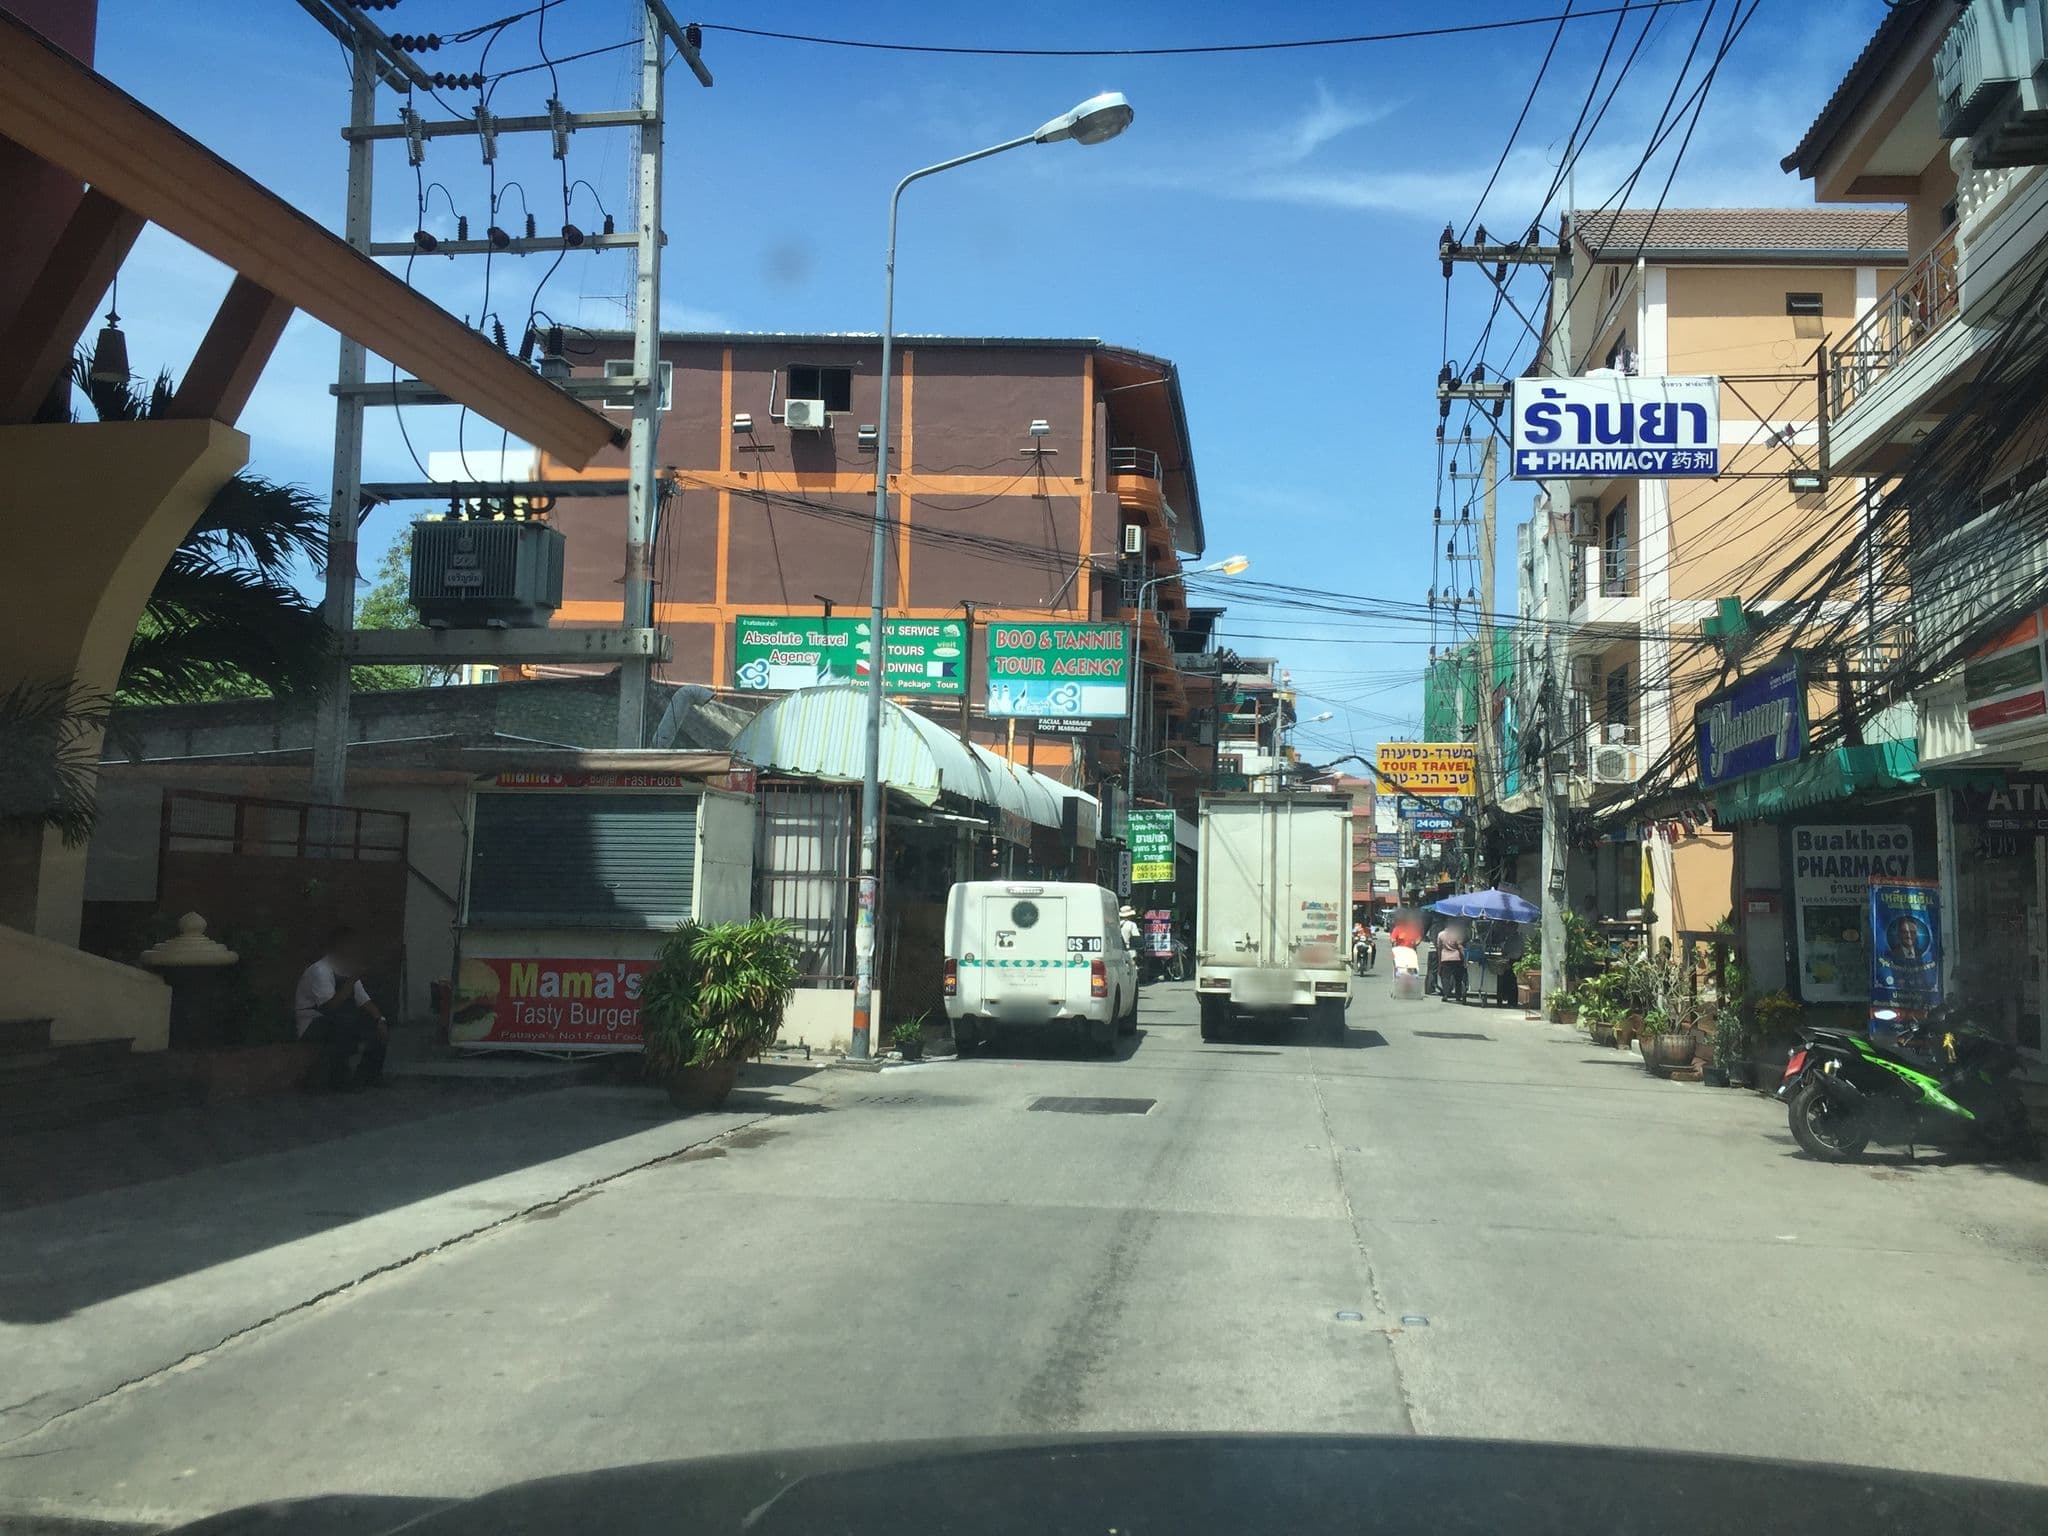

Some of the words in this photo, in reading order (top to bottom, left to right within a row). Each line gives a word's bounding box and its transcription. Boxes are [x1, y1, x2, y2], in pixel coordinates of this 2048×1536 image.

[1524, 388, 1708, 445] ร้านยา
[1548, 452, 1668, 470] PHARMACY
[1671, 451, 1714, 469] 药剂
[743, 631, 802, 646] Absolute
[807, 632, 848, 646] Travel
[898, 626, 940, 637] SERVICE
[996, 629, 1036, 649] BOO
[1039, 631, 1052, 650] &
[1054, 630, 1123, 650] TANNIE
[770, 649, 820, 665] Agency
[888, 646, 925, 656] TOURS
[888, 663, 924, 673] DIVING
[994, 657, 1045, 675] TOUR
[1051, 658, 1123, 676] AGENCY
[898, 680, 931, 689] Package
[1381, 748, 1473, 759] משרד-נסיעות
[1382, 762, 1417, 771] TOUR
[1422, 762, 1471, 771] TRAVEL
[1417, 819, 1428, 828] 24
[1429, 820, 1452, 828] OPEN
[1797, 829, 1908, 850] Buakhao
[1797, 855, 1909, 877] PHARMACY
[1068, 938, 1083, 951] CS
[1087, 938, 1100, 951] 10
[510, 962, 643, 1000] Mama's
[512, 1001, 563, 1030] Tasty
[570, 1002, 641, 1031] Burger
